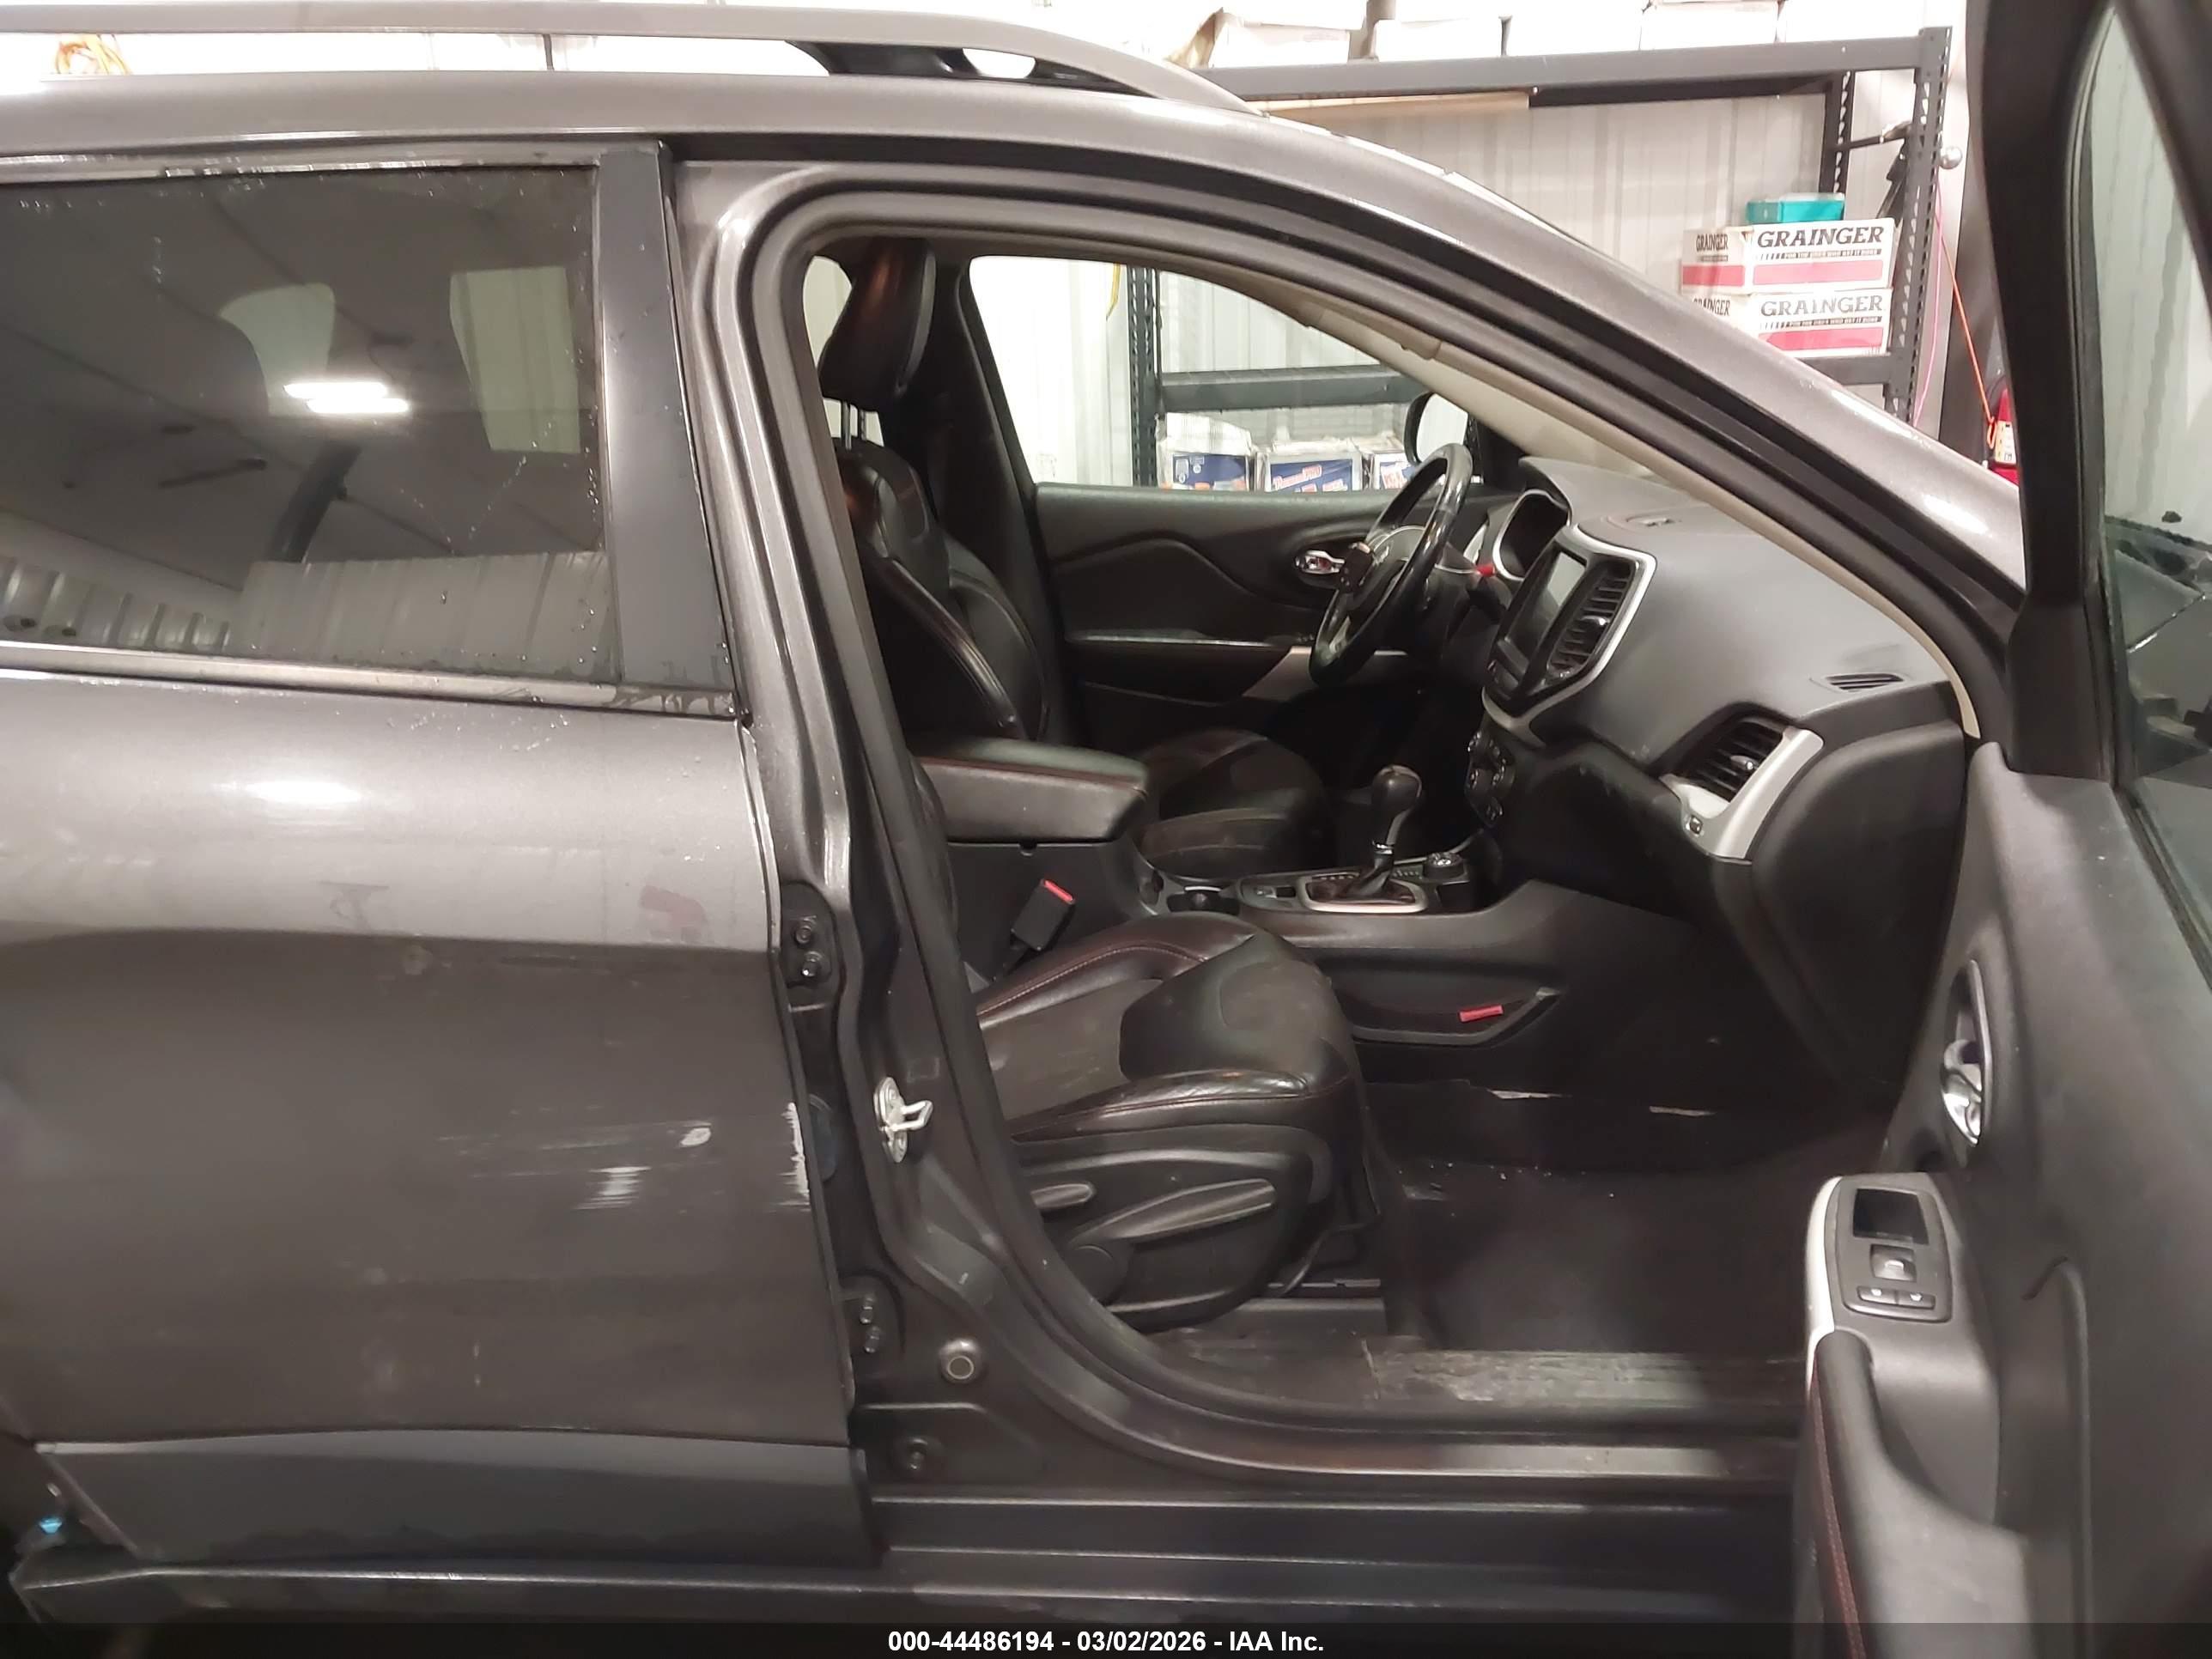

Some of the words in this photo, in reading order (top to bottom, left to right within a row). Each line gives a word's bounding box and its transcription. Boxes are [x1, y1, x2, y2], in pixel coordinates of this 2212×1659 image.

[1696, 234, 1728, 252] GRAINGER
[1757, 226, 1884, 247] GRAINGER
[1692, 298, 1730, 316] AINGER
[1760, 295, 1883, 317] GRAINGER
